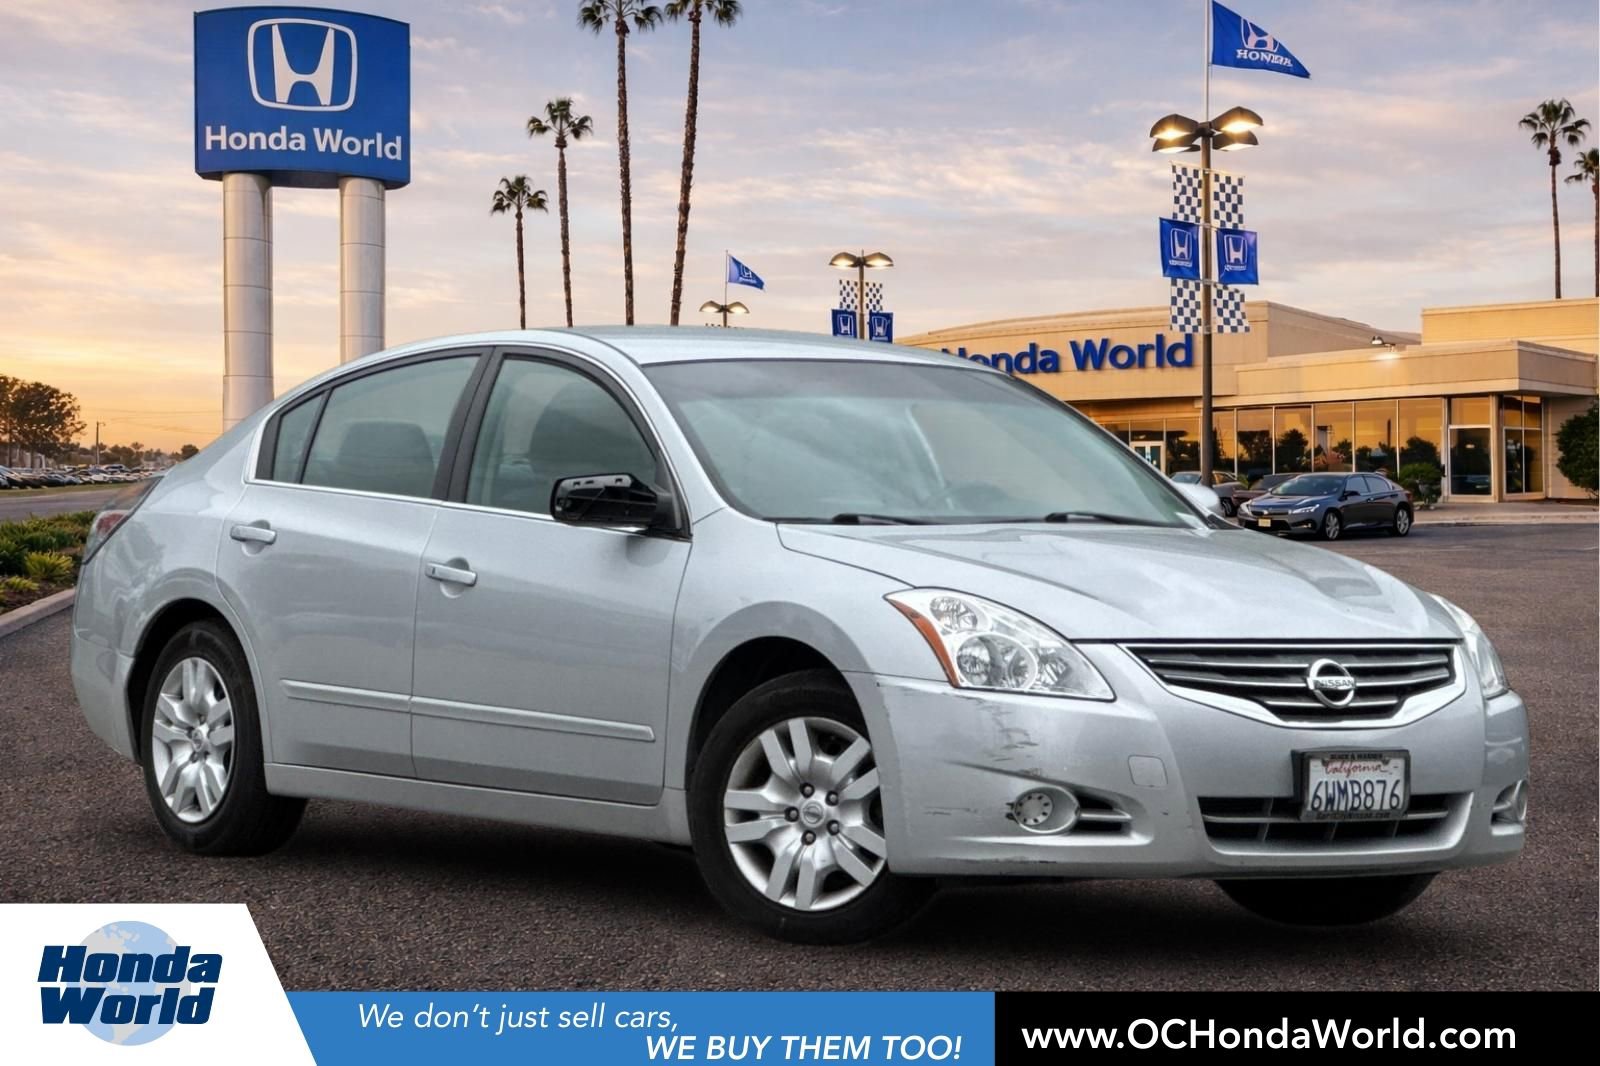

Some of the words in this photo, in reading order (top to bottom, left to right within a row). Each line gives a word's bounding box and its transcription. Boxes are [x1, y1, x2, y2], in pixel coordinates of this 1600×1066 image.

[205, 125, 306, 151] Honda
[313, 127, 402, 161] World
[941, 342, 1061, 374] nda
[1069, 333, 1195, 371] World
[1311, 779, 1401, 811] 6WMB876
